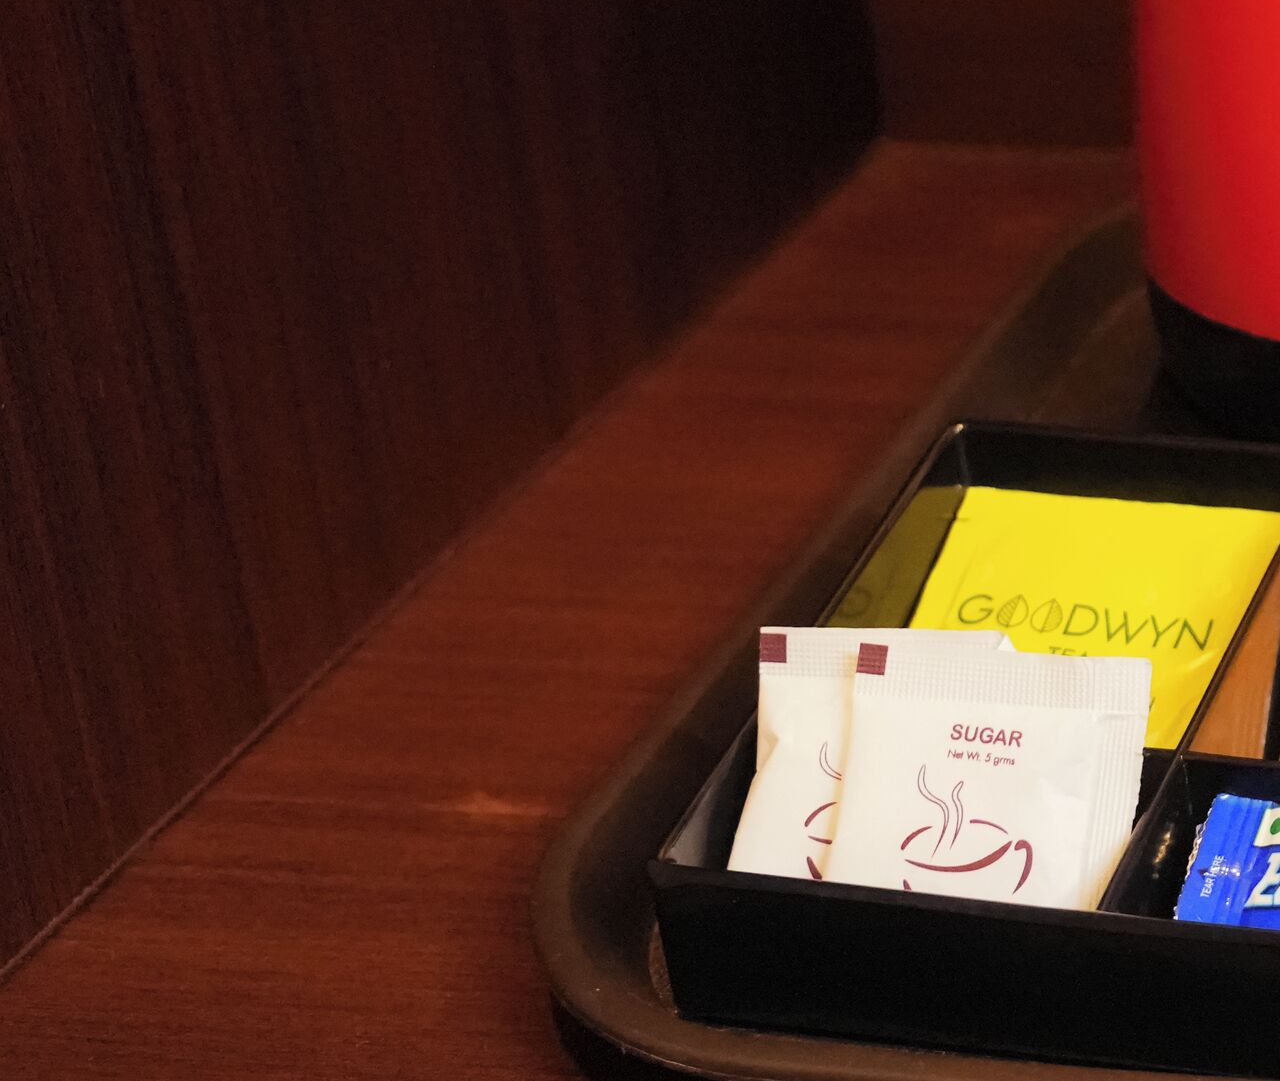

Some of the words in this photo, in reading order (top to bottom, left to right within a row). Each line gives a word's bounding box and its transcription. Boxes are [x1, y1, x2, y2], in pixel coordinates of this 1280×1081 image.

[957, 593, 1214, 652] GOODWYN
[950, 723, 1023, 748] SUGAR
[984, 752, 992, 763] 5
[993, 756, 1016, 767] grms
[1200, 877, 1217, 898] TEAR
